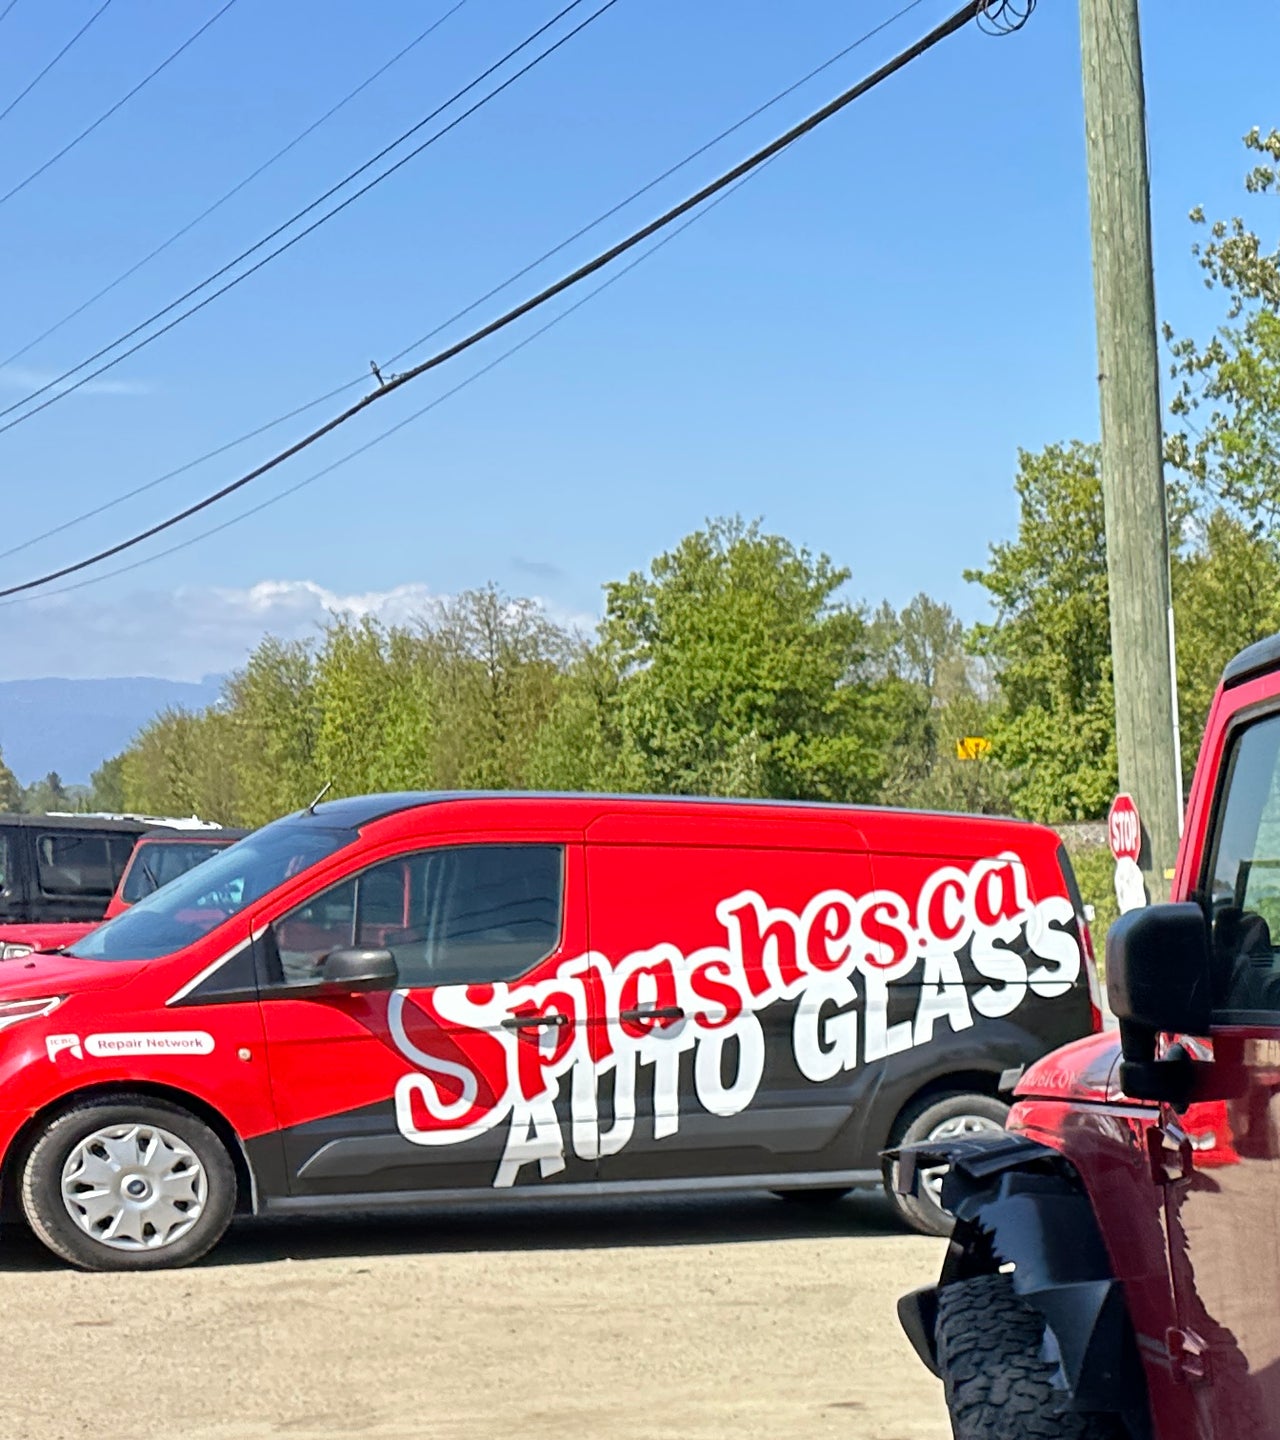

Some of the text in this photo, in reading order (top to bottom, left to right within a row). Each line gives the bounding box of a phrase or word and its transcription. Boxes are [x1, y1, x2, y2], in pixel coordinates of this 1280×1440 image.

[1111, 811, 1137, 853] STOP
[97, 1037, 204, 1051] Repair Network
[388, 852, 1034, 1146] Splashes.ca
[493, 896, 1081, 1188] AUTO GLASS
